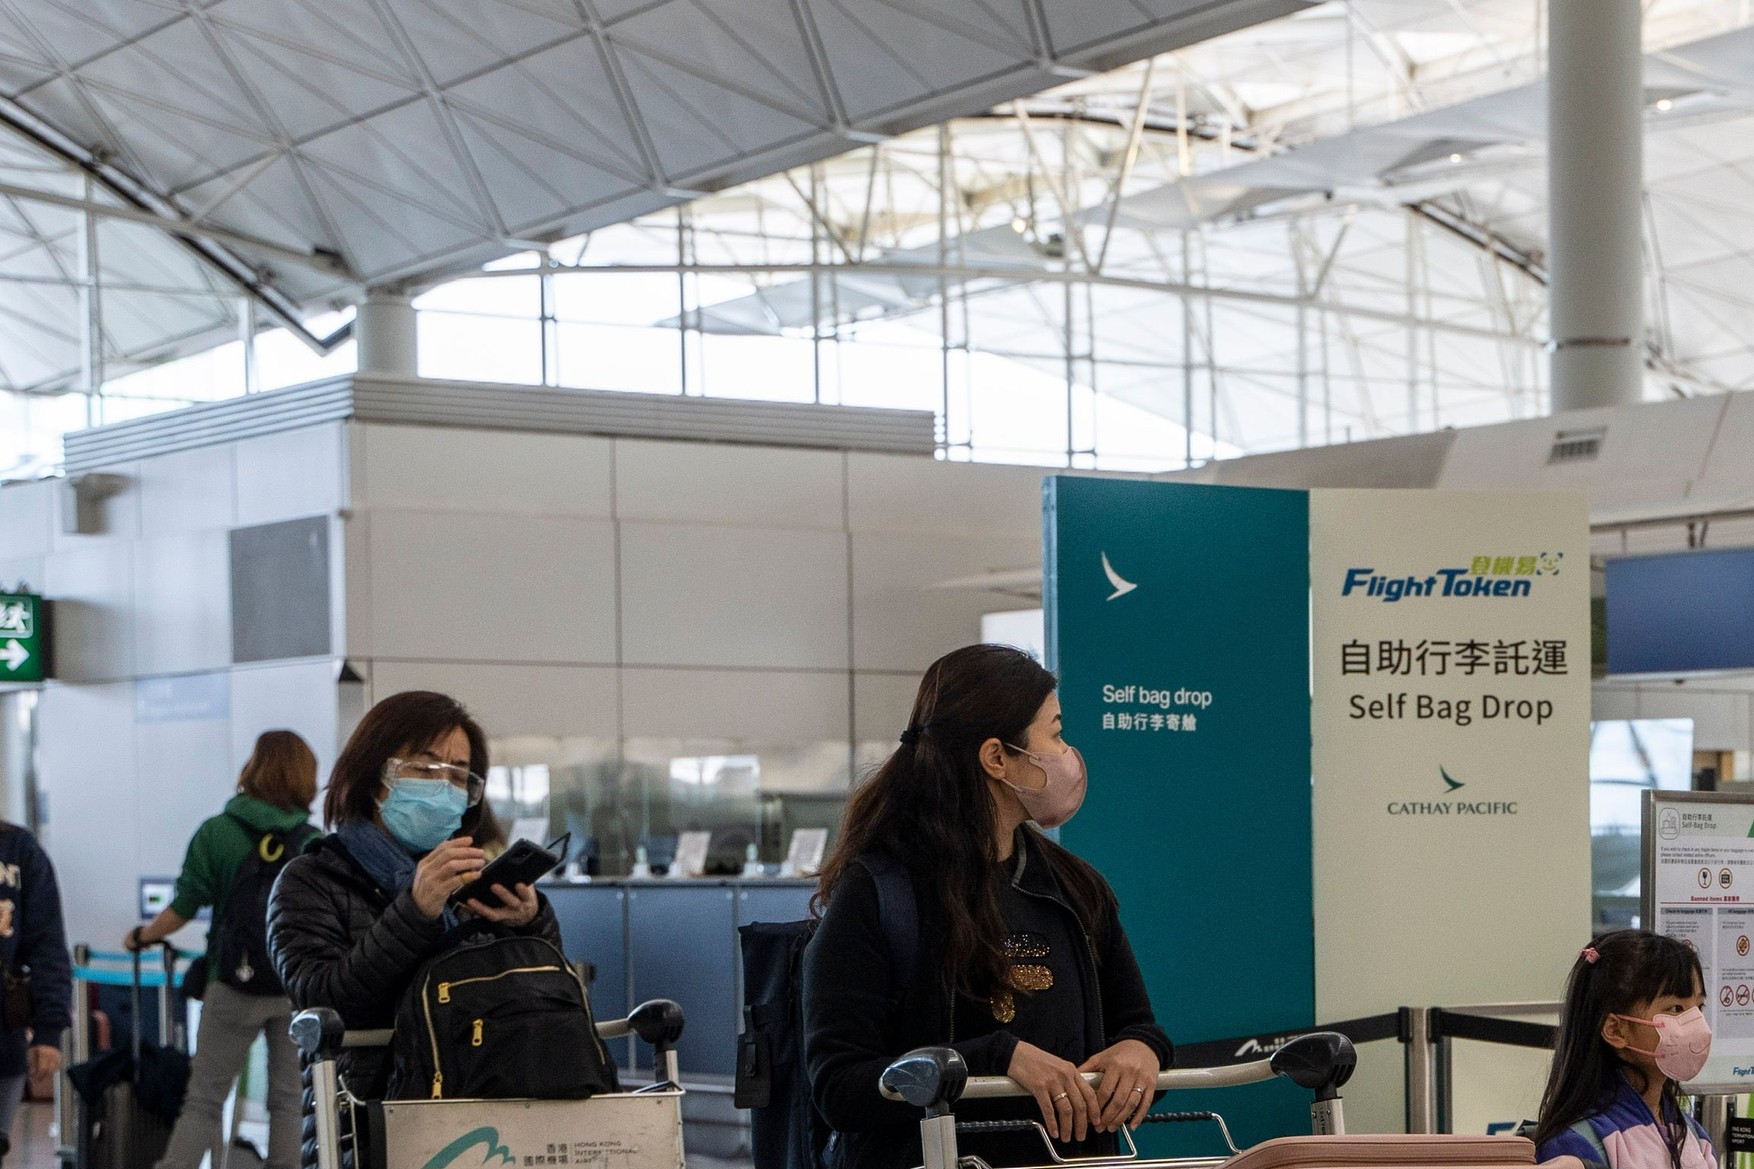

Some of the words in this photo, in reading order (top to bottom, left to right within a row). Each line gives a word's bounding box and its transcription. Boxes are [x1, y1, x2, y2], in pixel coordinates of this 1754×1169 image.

[1340, 638, 1569, 677] 自助行李託運
[1102, 684, 1137, 705] Self
[1139, 685, 1171, 708] bag
[1174, 688, 1213, 710] drop
[1349, 692, 1407, 721] Self
[1416, 694, 1472, 725] Bag
[1482, 692, 1554, 726] Drop
[1387, 801, 1453, 815] CATHAY
[1457, 801, 1518, 815] PACIFIC
[1704, 822, 1717, 830] Drop
[574, 1148, 639, 1156] INTERNTIONAL
